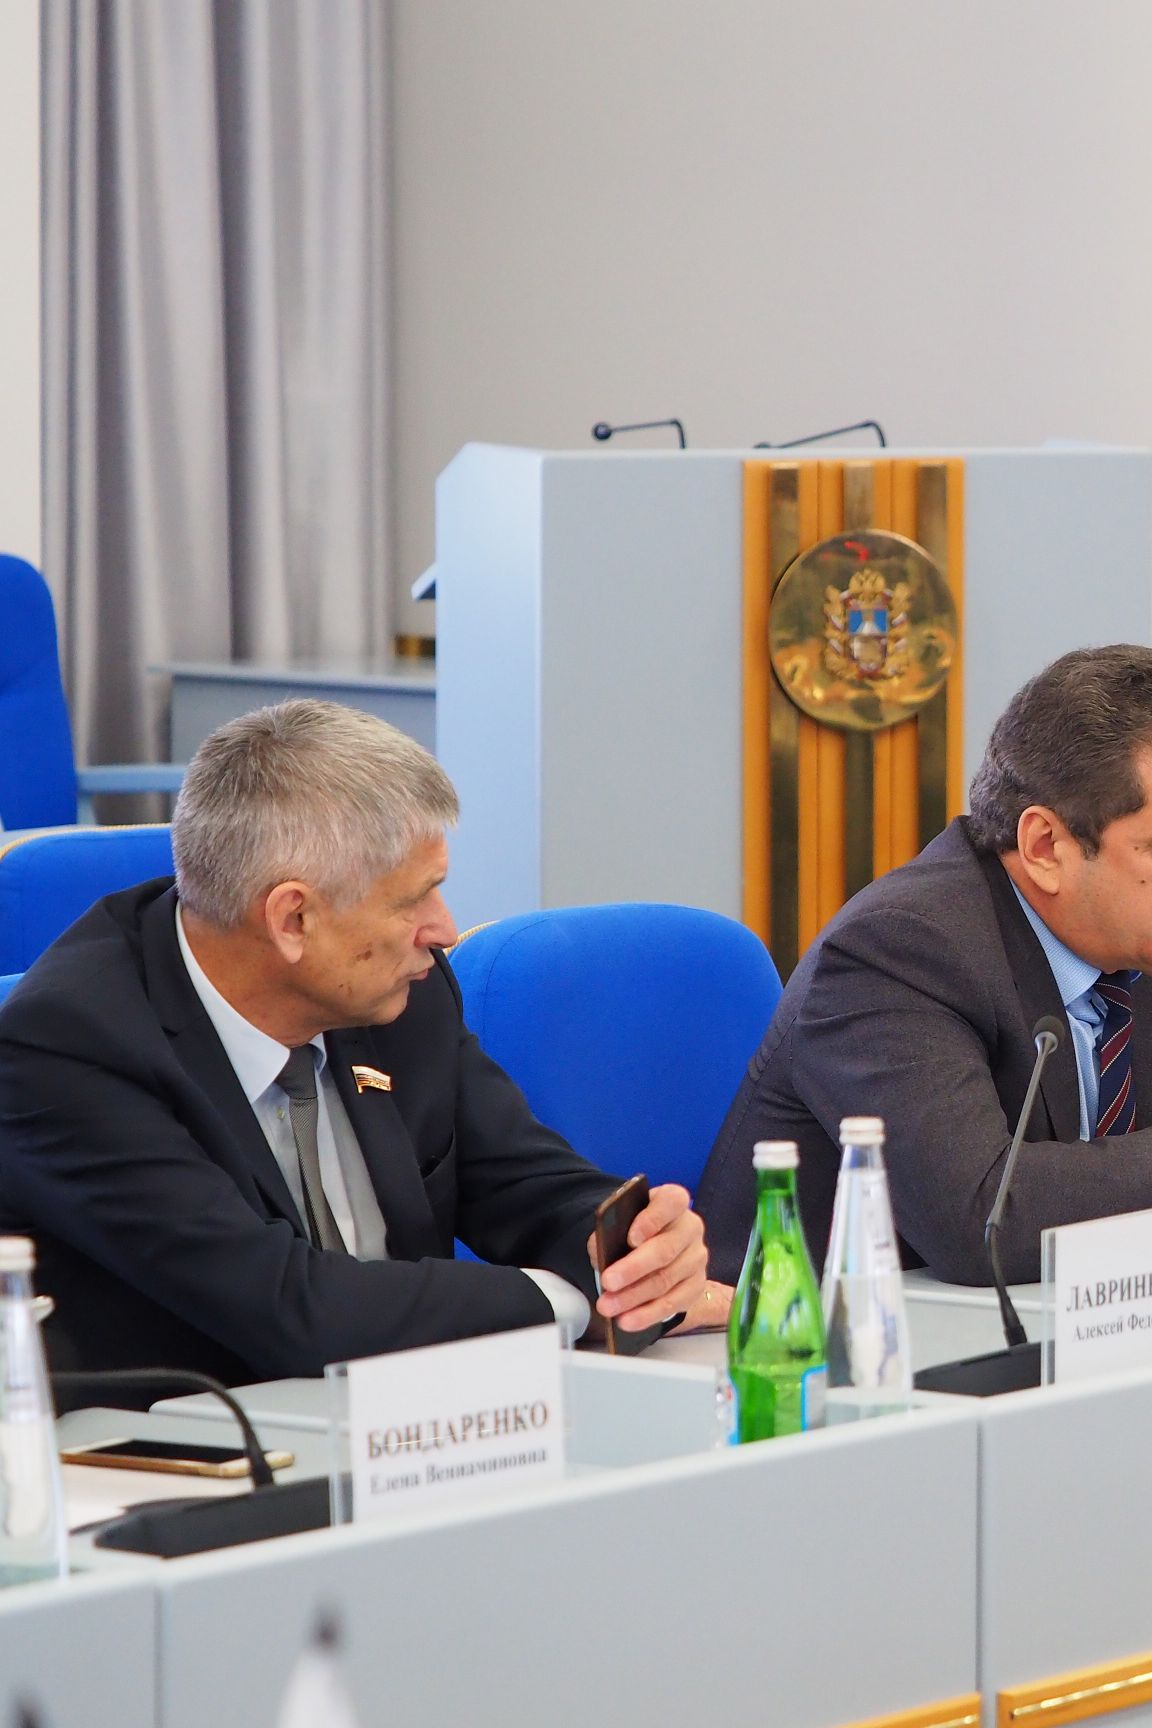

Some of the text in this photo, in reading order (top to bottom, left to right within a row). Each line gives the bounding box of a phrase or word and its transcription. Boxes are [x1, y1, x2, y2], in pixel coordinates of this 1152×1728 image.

[1073, 1316, 1123, 1342] Алексей
[368, 1402, 548, 1459] БОНДАРЕНКО
[372, 1475, 419, 1495] Елена
